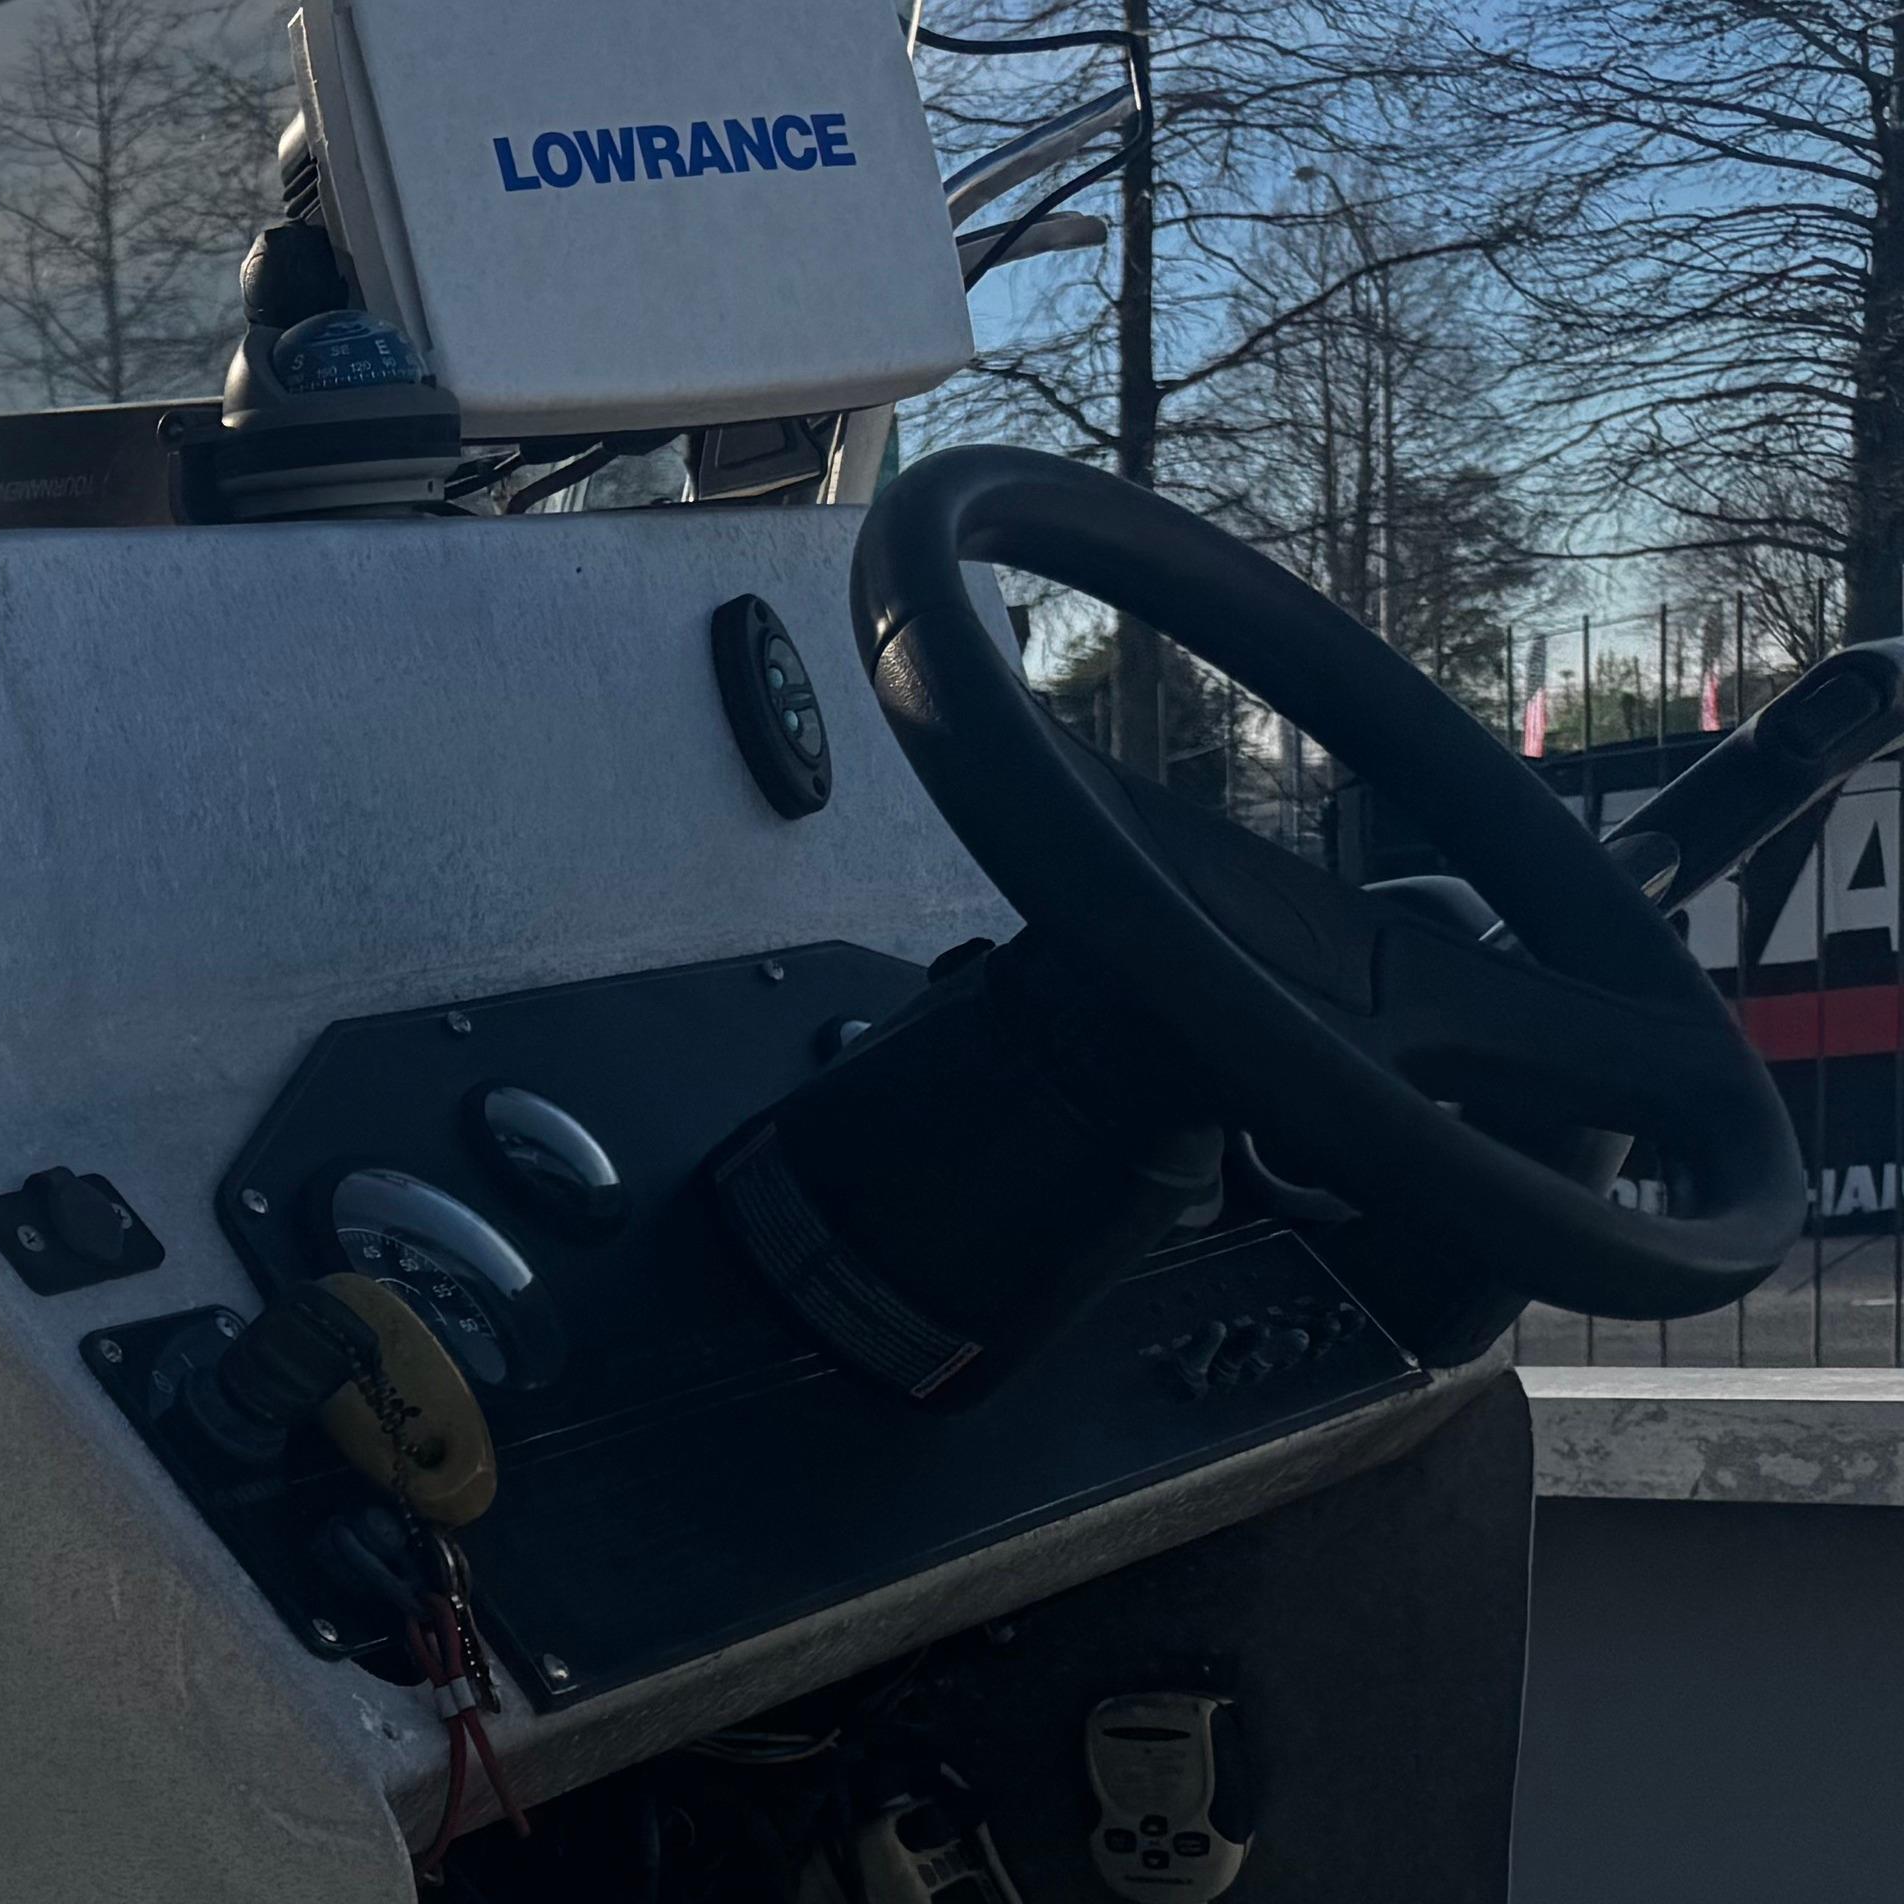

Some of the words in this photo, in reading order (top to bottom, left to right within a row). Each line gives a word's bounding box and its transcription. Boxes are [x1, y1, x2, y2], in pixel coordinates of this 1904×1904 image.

[493, 113, 857, 191] LOWRANCE
[331, 345, 350, 357] SE
[375, 339, 390, 354] E
[350, 360, 372, 373] 120
[432, 1283, 453, 1299] 55
